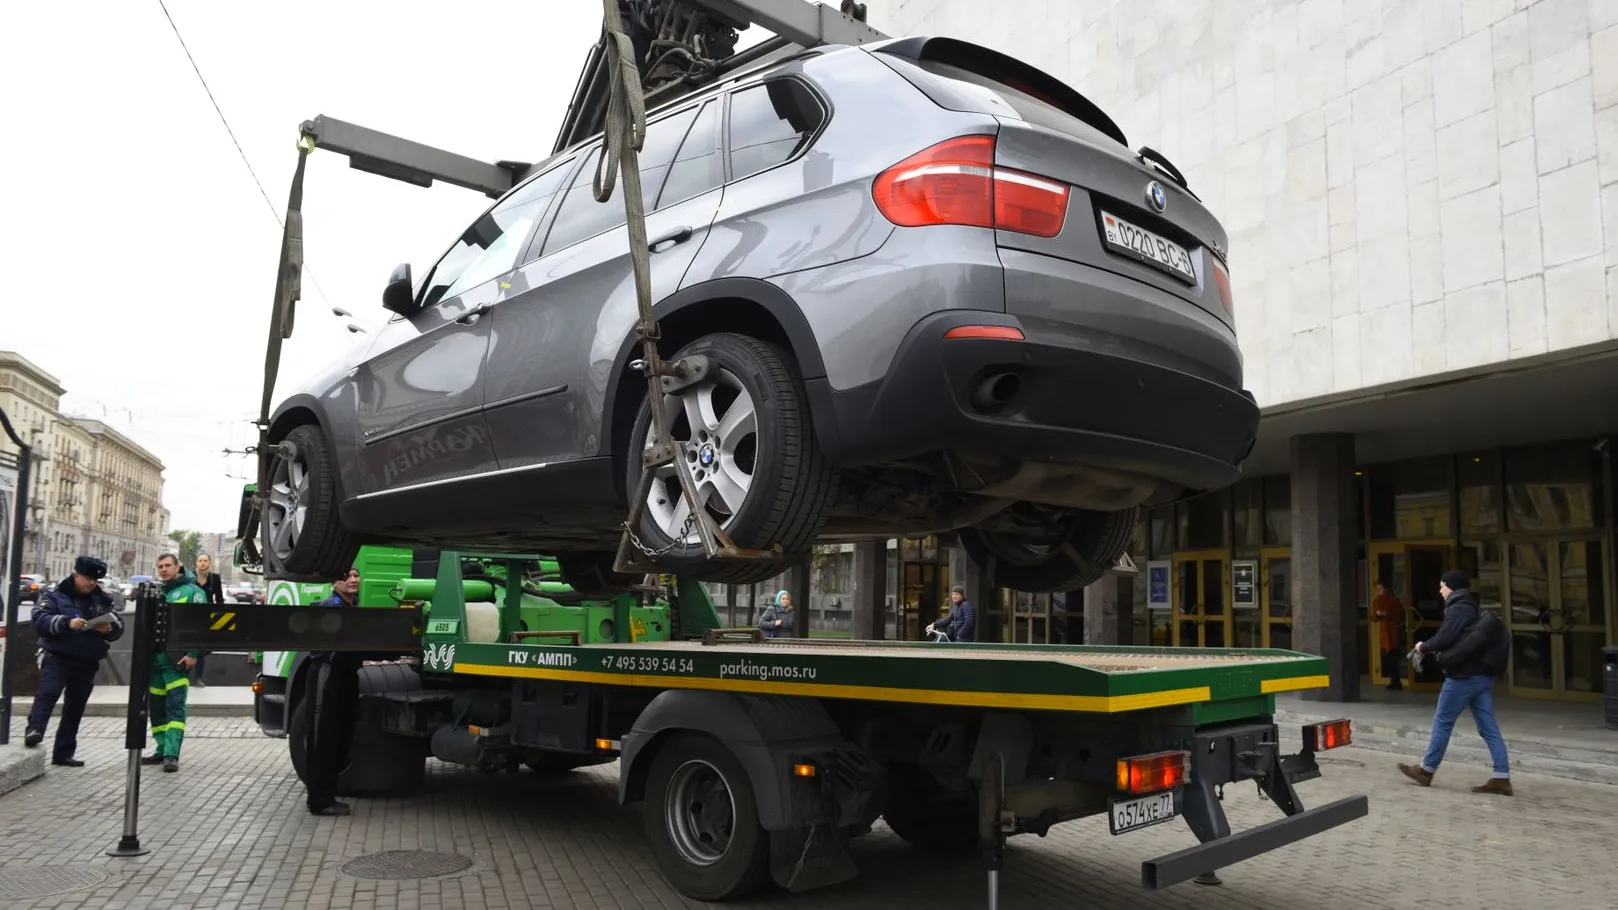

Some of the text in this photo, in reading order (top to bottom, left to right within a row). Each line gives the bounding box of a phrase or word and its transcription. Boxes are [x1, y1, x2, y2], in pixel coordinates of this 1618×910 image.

[1118, 222, 1155, 258] 0220
[508, 650, 529, 664] ГКУ
[601, 655, 694, 673] +7 495 539 54 54
[719, 658, 817, 681] parking.mos.ru
[1160, 794, 1170, 812] 77
